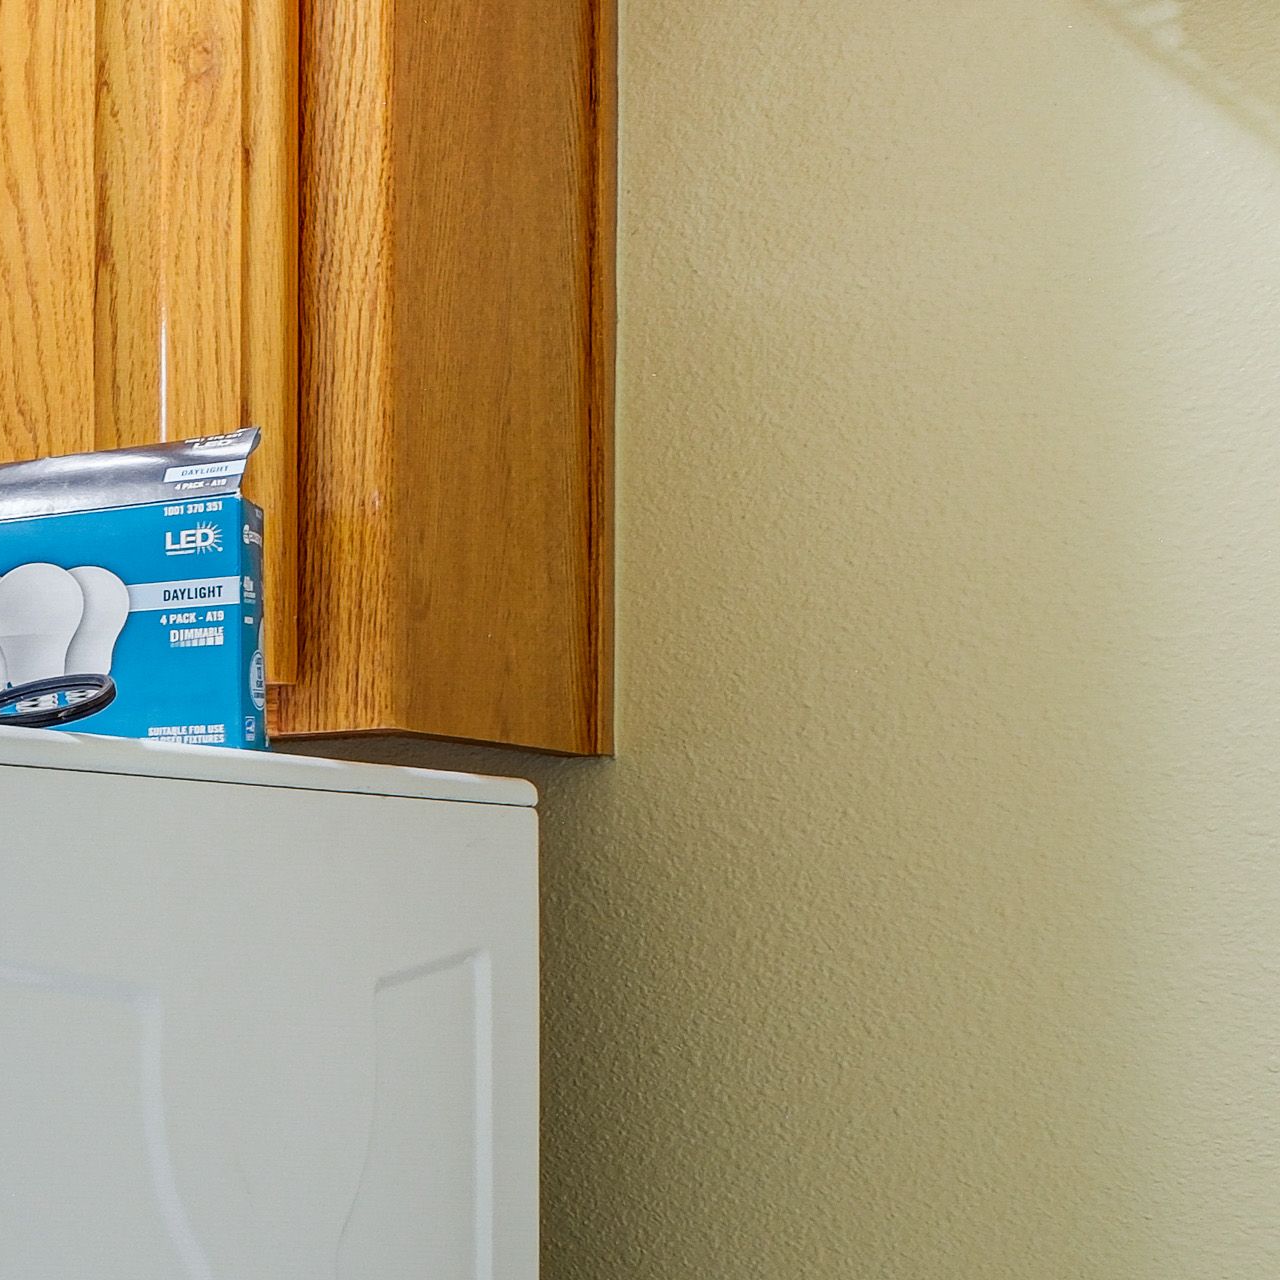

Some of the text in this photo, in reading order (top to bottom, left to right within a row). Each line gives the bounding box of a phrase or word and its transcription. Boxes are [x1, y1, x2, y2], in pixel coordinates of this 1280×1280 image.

[181, 466, 229, 476] DAYLIGHT
[165, 528, 215, 550] LED
[163, 585, 223, 602] DAYLIGHT
[159, 614, 168, 626] 4
[169, 612, 197, 624] PACK
[205, 610, 224, 622] A19
[169, 626, 224, 642] DIMMABLE
[148, 724, 225, 736] SUITABLE FOR USE
